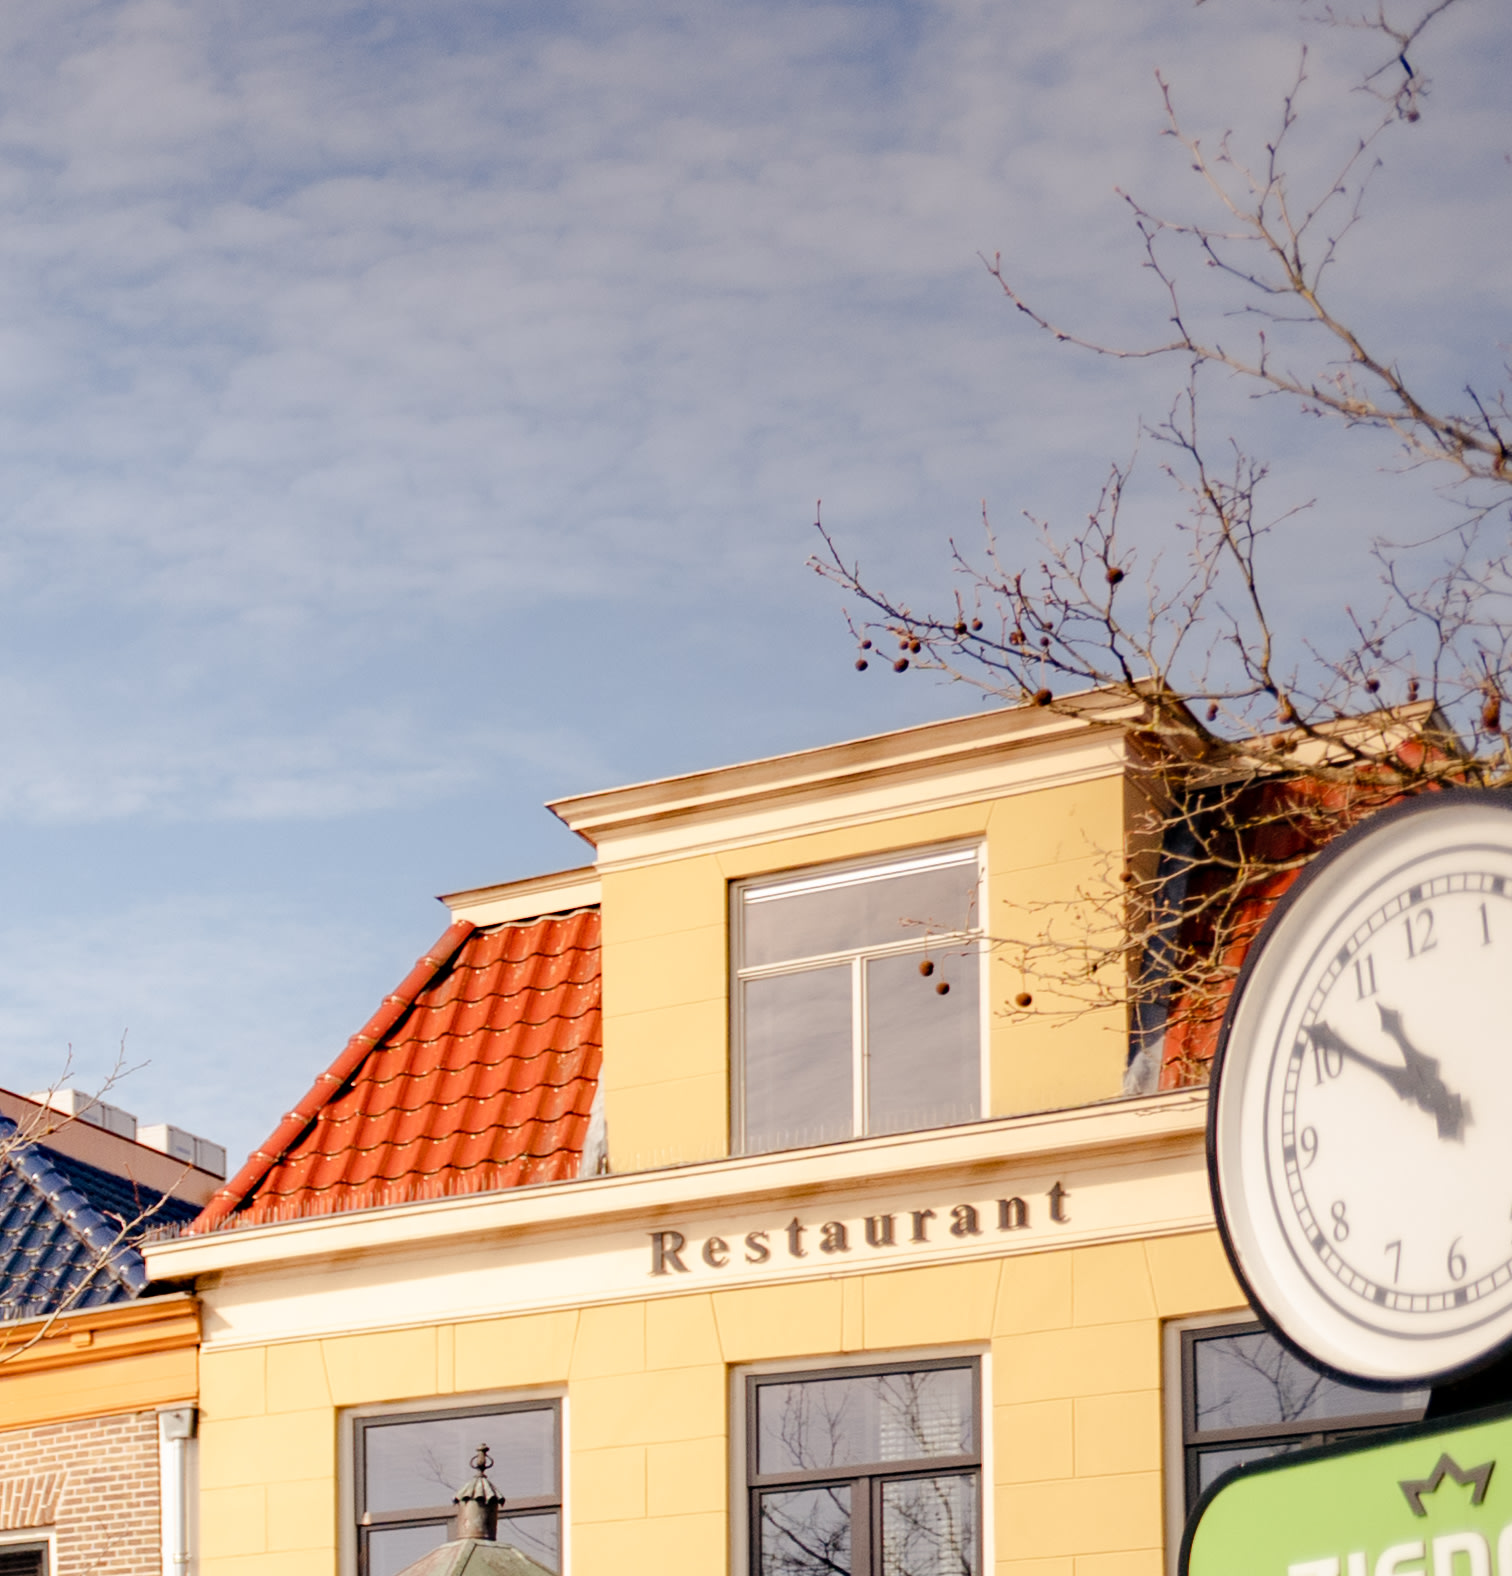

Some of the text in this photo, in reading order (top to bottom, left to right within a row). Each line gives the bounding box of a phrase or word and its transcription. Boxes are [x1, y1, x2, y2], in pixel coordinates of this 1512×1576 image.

[1403, 907, 1438, 959] 12
[1480, 902, 1492, 946] 1
[1353, 953, 1377, 1001] 11
[1300, 1125, 1318, 1170] 9
[647, 1181, 1071, 1277] Restaurant
[1331, 1200, 1349, 1242] 8
[1384, 1240, 1401, 1284] 7
[1447, 1235, 1467, 1282] 6
